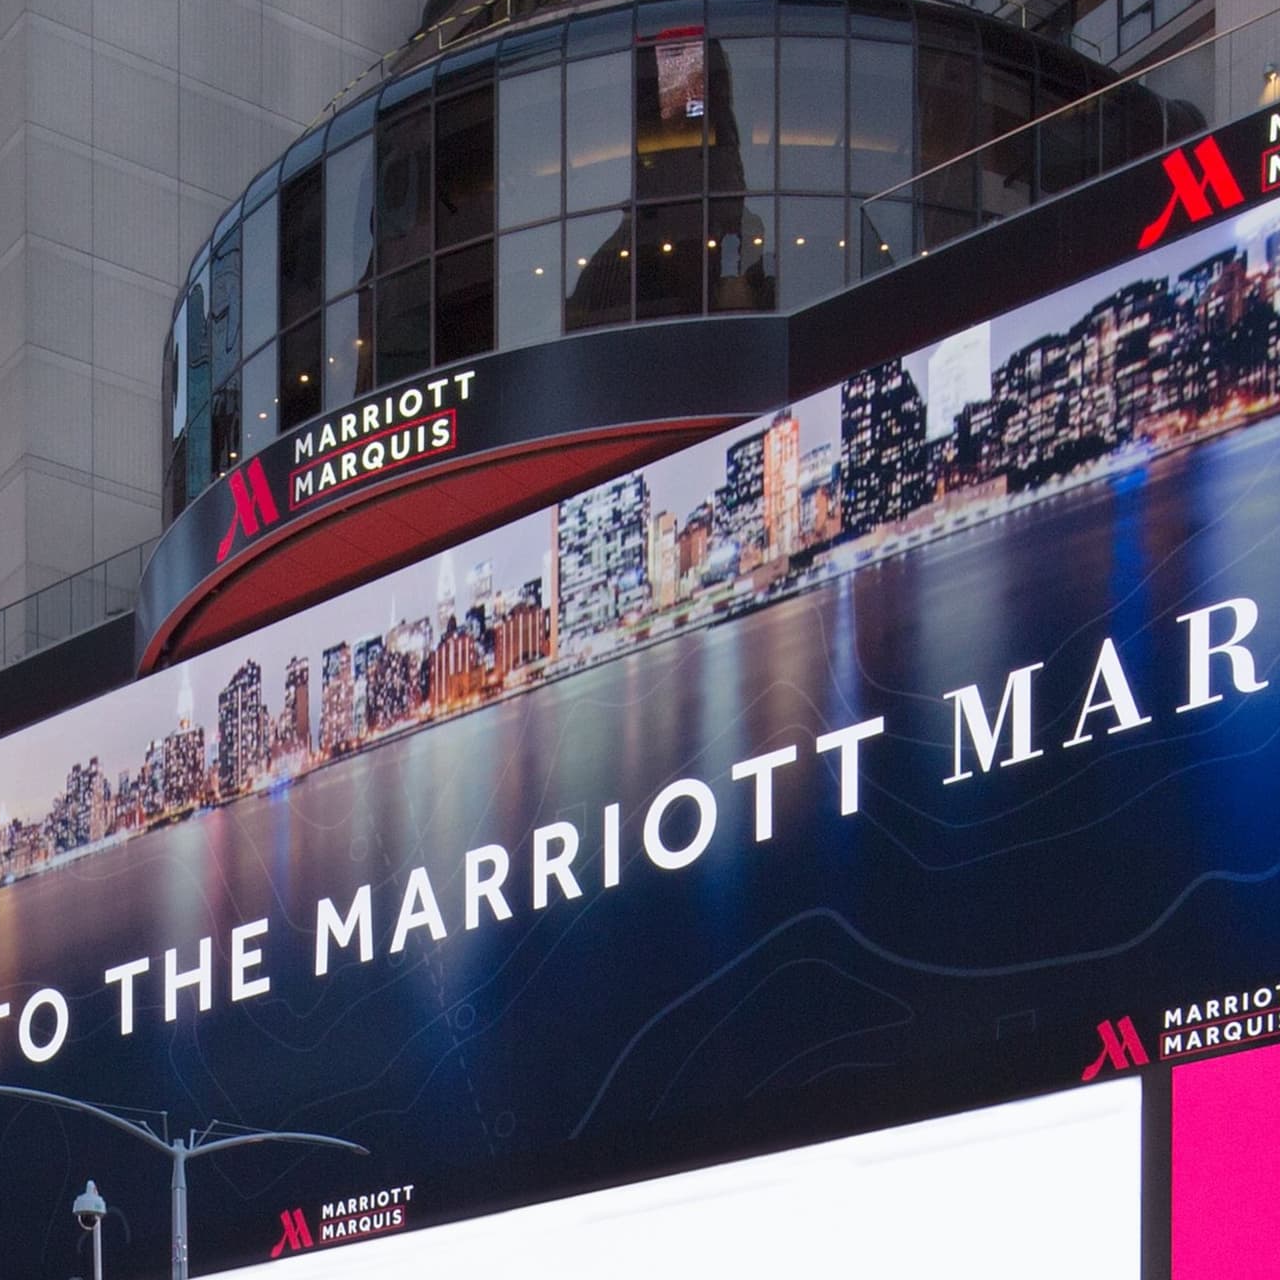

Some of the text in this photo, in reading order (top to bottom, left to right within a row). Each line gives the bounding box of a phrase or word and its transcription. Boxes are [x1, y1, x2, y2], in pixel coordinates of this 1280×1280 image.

[295, 370, 476, 465] MARRIOTT
[294, 418, 451, 504] MARQUIS
[104, 918, 271, 1035] THE
[315, 716, 885, 976] MARRIOTT
[322, 1184, 414, 1219] MARRIOTT
[322, 1209, 402, 1240] MARQUIS
